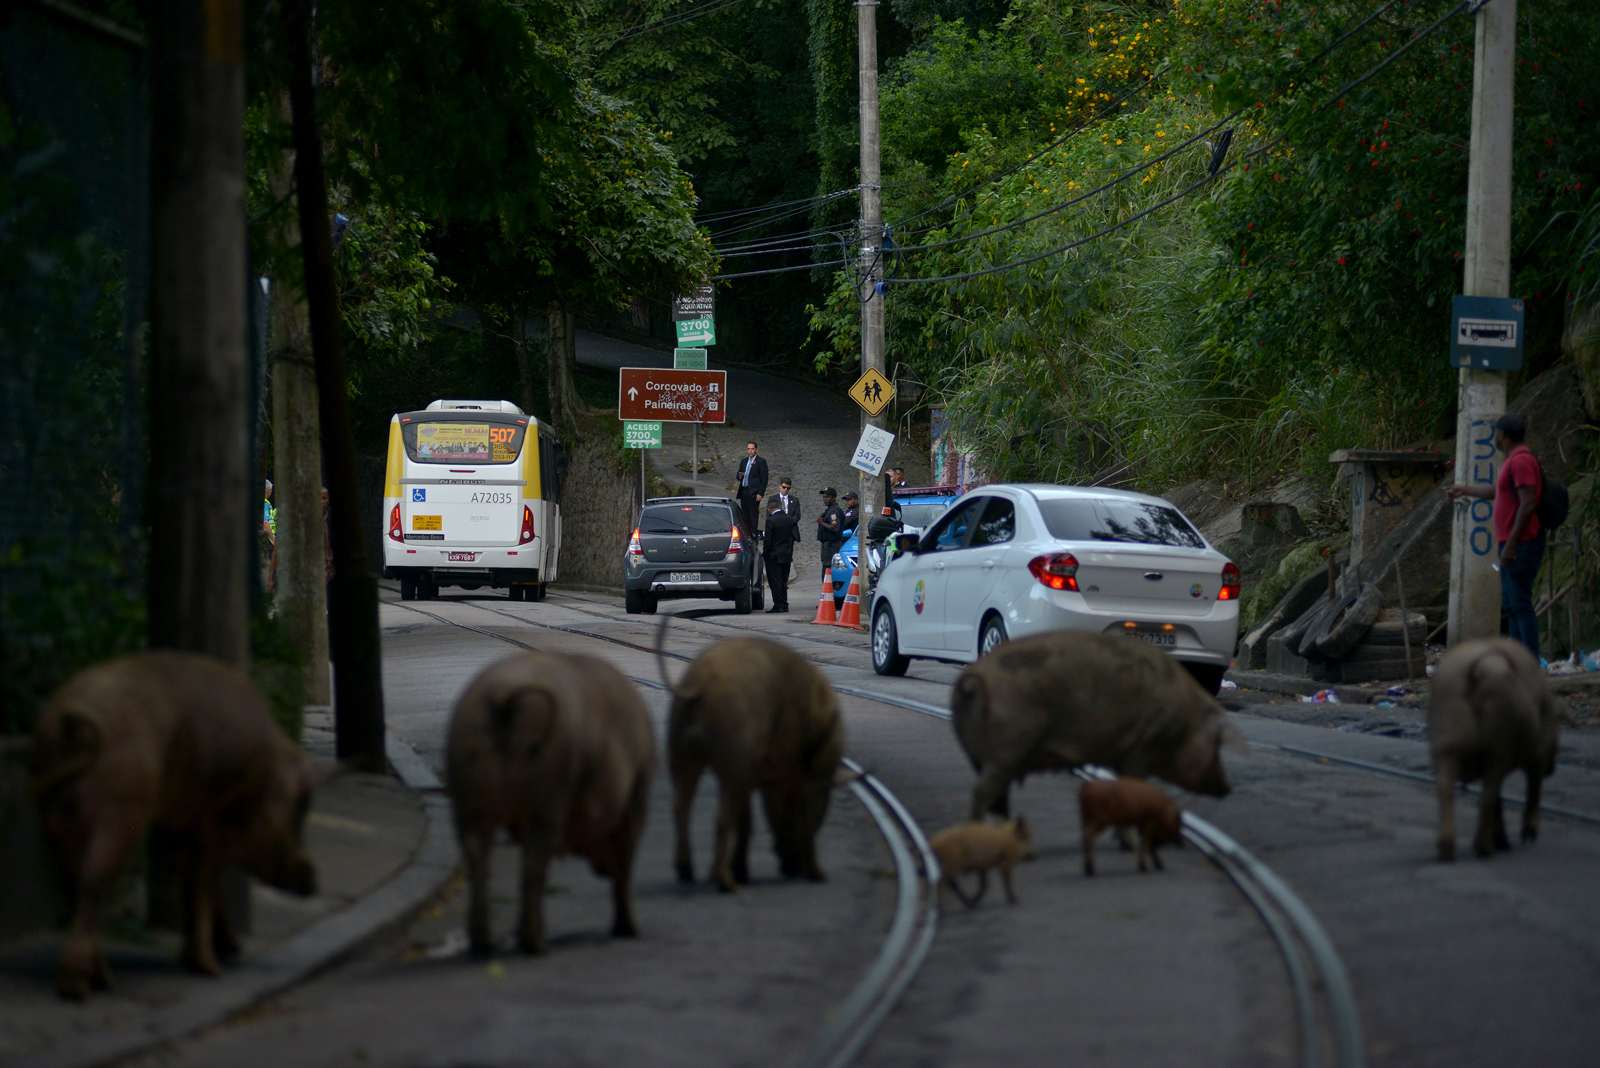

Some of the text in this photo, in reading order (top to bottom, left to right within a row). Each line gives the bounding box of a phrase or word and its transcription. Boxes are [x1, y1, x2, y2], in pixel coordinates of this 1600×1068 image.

[681, 320, 710, 331] 3700
[645, 381, 702, 392] Corcovado
[644, 399, 692, 410] Paineiras
[490, 428, 515, 443] 507
[626, 431, 650, 439] 3700
[857, 448, 882, 465] 3476
[471, 493, 512, 504] A72035
